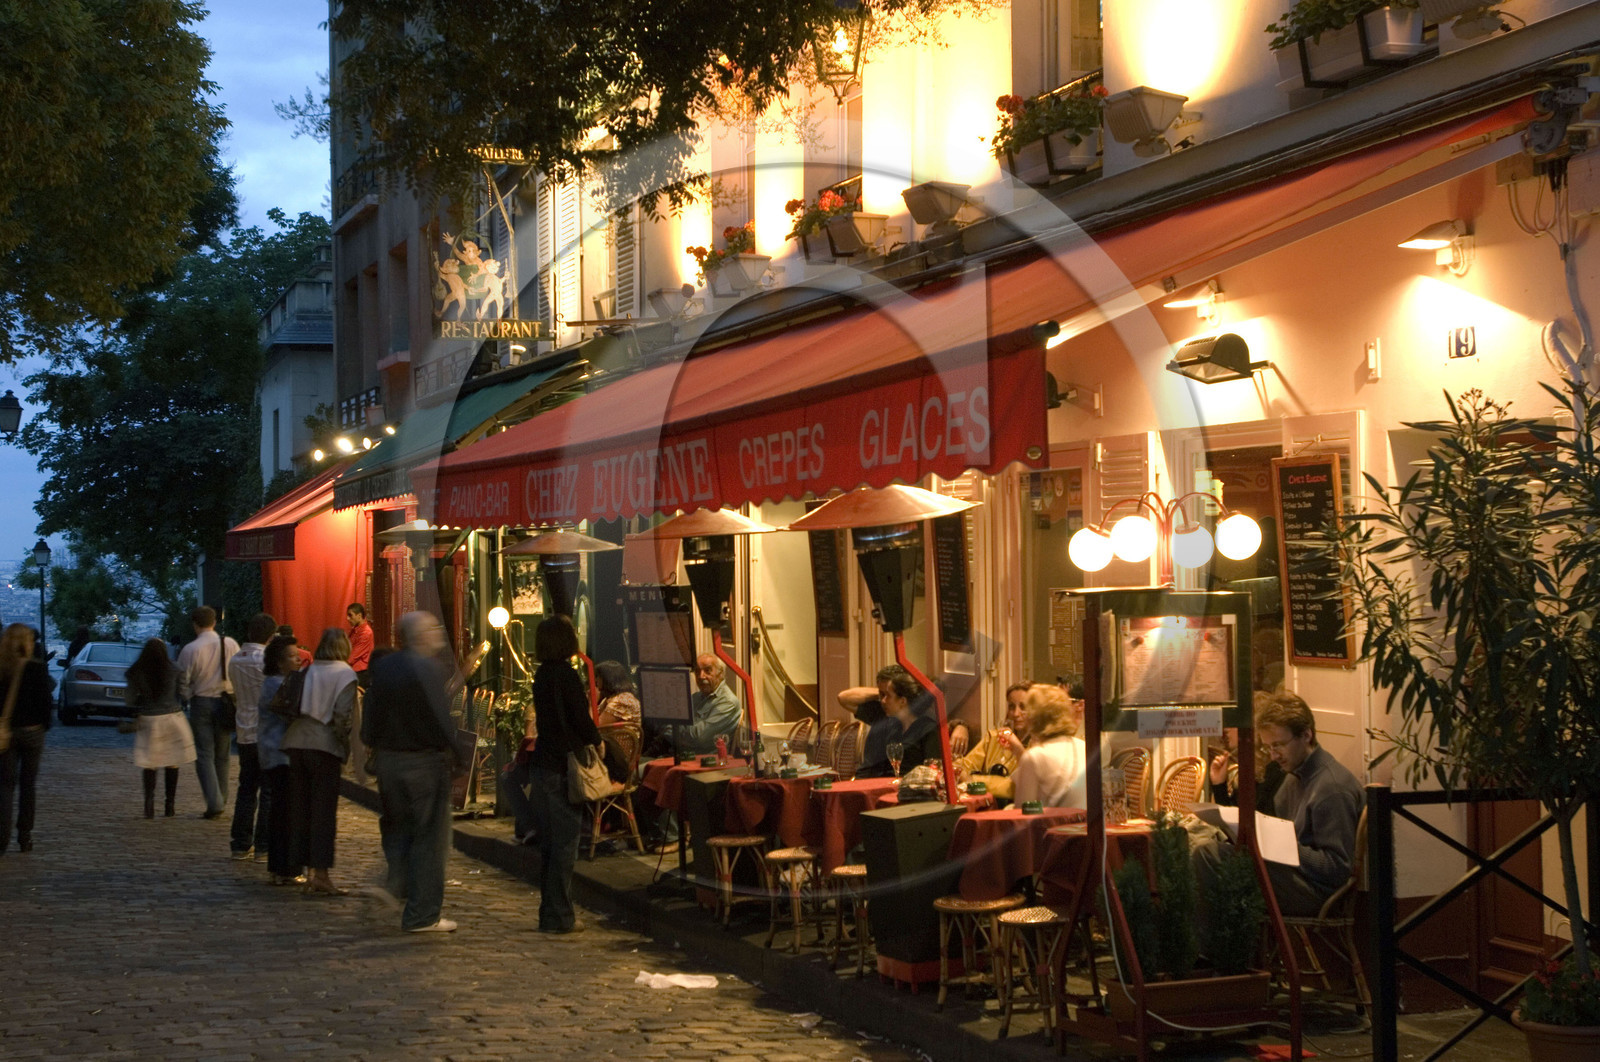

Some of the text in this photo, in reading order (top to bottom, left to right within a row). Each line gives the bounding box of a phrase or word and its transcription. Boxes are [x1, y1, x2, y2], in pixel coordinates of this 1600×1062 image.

[441, 320, 542, 338] RESTAURANT
[1449, 327, 1475, 357] 19
[449, 481, 510, 518] PIANO-BAR
[526, 464, 579, 521] CHEZ
[591, 438, 715, 514] EUGENE
[738, 423, 825, 489] CREPES
[860, 386, 991, 469] GLACES
[629, 590, 666, 600] MENU
